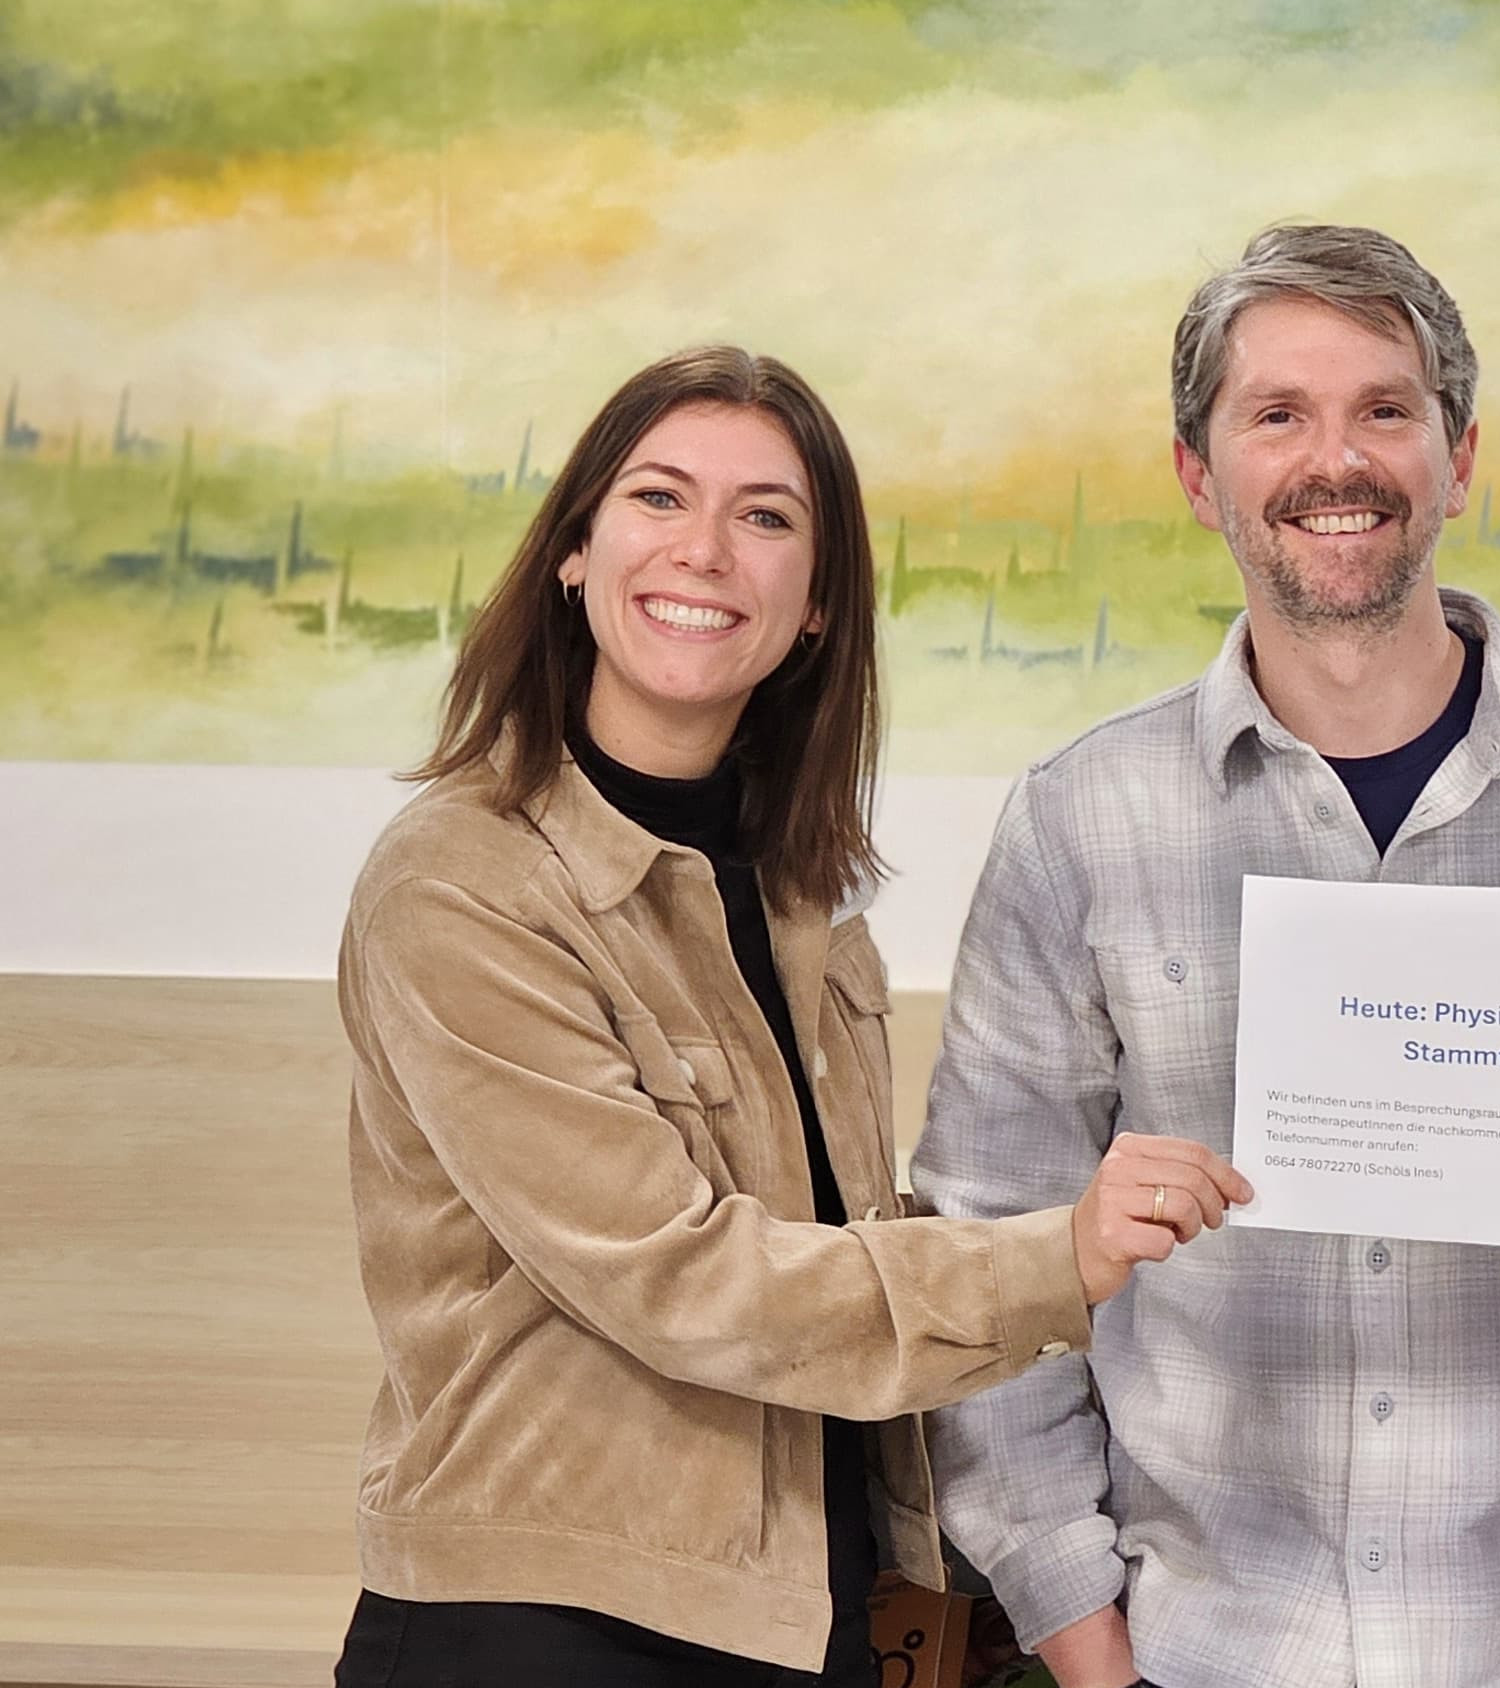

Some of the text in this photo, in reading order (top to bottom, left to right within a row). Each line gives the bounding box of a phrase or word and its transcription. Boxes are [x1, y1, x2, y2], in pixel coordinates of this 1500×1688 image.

[1340, 996, 1426, 1021] Heute:
[1266, 1090, 1289, 1101] Wir
[1292, 1092, 1346, 1107] befinden
[1349, 1099, 1373, 1110] uns
[1375, 1099, 1391, 1111] im
[1266, 1109, 1403, 1132] PhysiotherapeutInnen
[1406, 1122, 1425, 1132] die
[1265, 1129, 1419, 1152] Telefonnummer anrufen:
[1264, 1154, 1296, 1168] 0664
[1299, 1158, 1361, 1174] 78072270
[1413, 1166, 1444, 1181] Ines)
